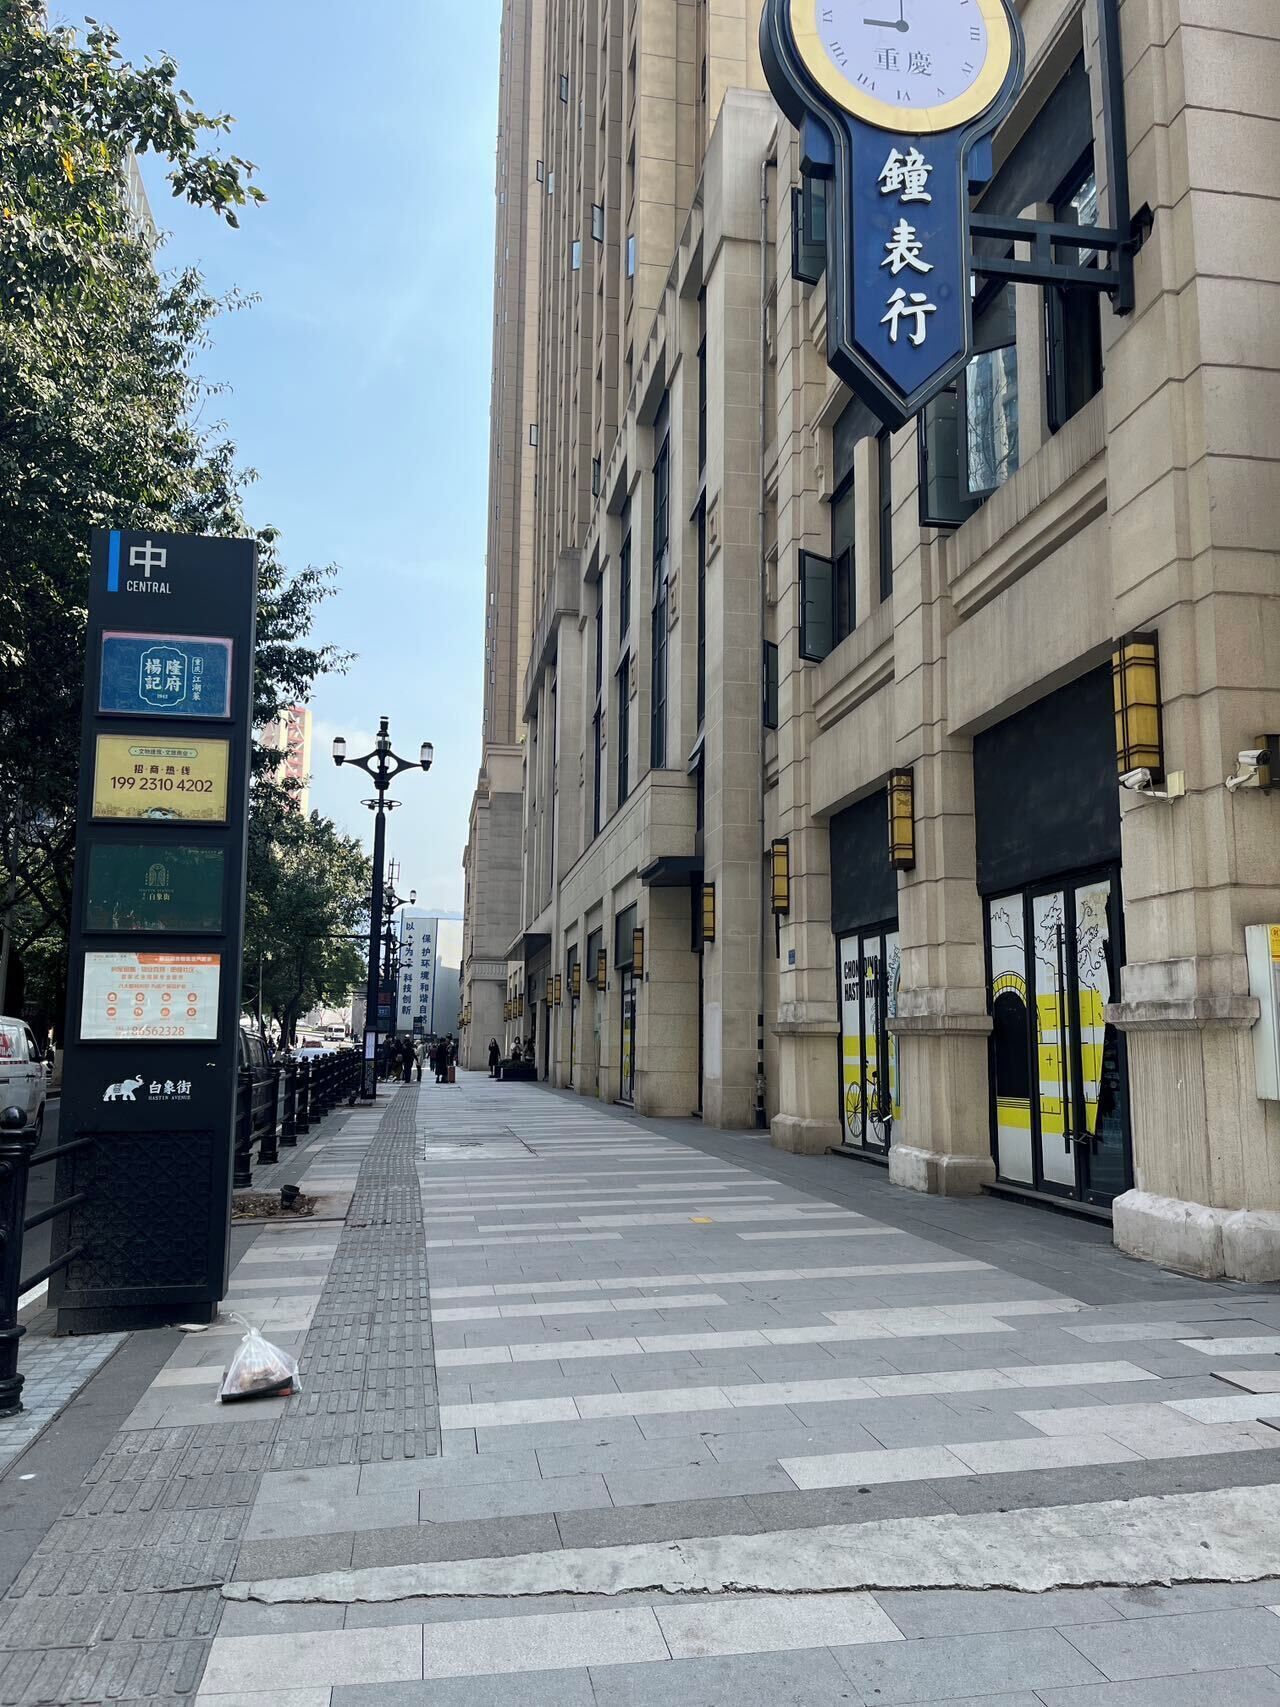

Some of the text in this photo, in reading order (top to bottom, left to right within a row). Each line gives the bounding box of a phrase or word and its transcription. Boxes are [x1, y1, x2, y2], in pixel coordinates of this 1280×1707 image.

[873, 47, 932, 77] 重慶
[877, 146, 937, 345] 鐘表行
[129, 540, 167, 577] 中
[126, 580, 172, 594] CENTRAL
[111, 776, 213, 792] 199 2310 4202
[149, 1079, 192, 1095] 白象街
